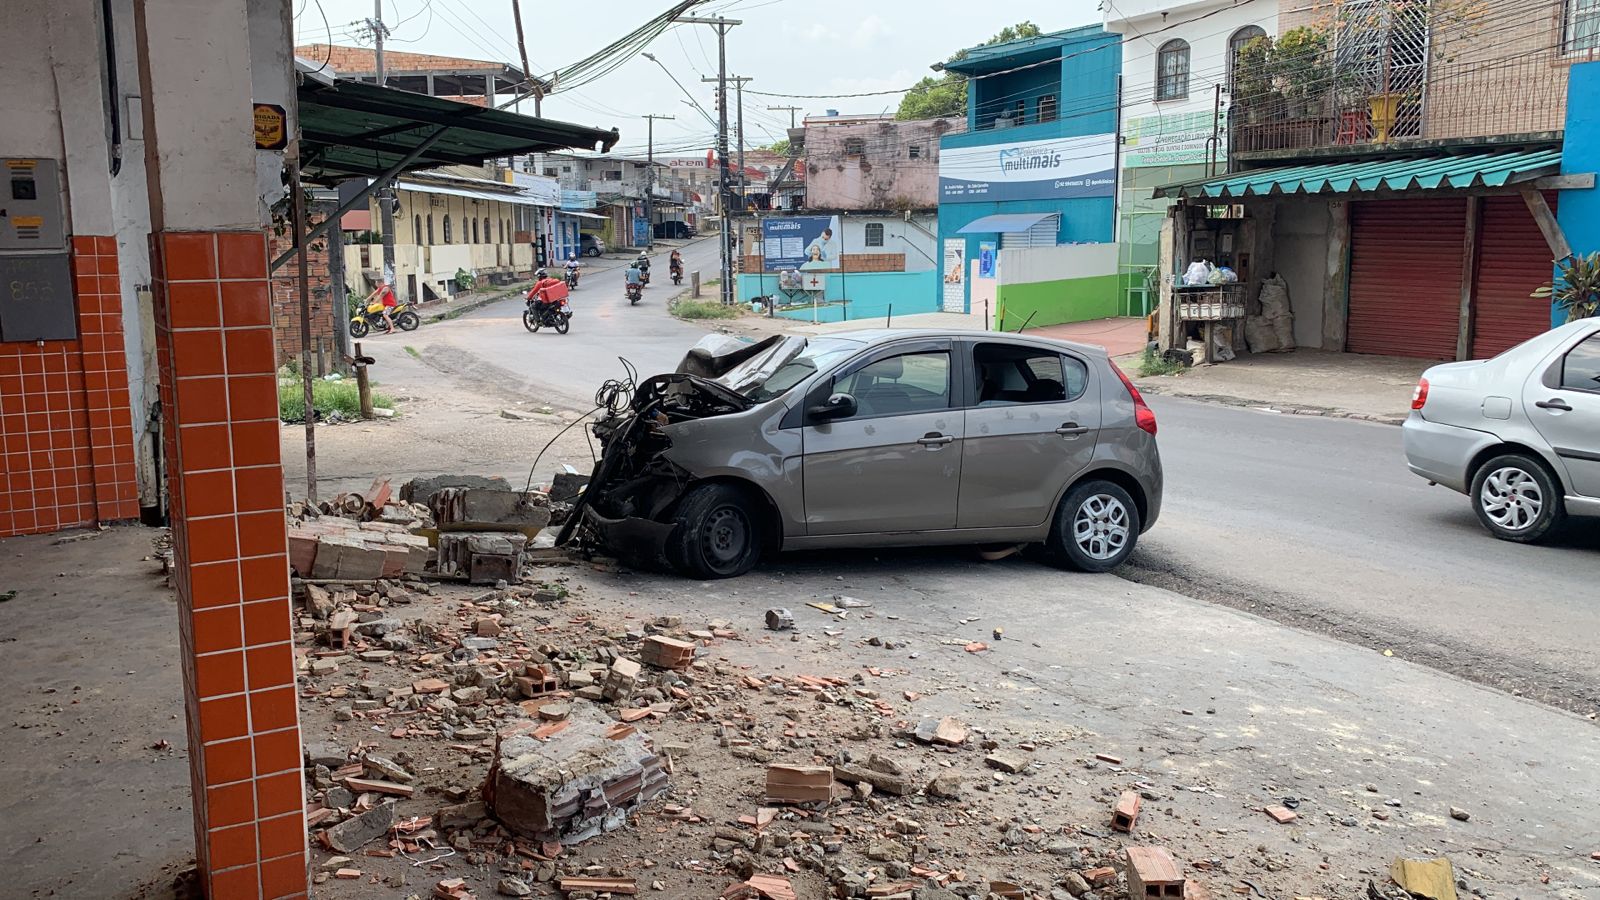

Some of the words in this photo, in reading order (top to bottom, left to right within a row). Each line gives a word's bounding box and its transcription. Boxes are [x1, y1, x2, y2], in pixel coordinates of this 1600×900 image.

[670, 159, 704, 167] atem
[1005, 150, 1061, 171] multimais
[769, 222, 801, 231] multimais
